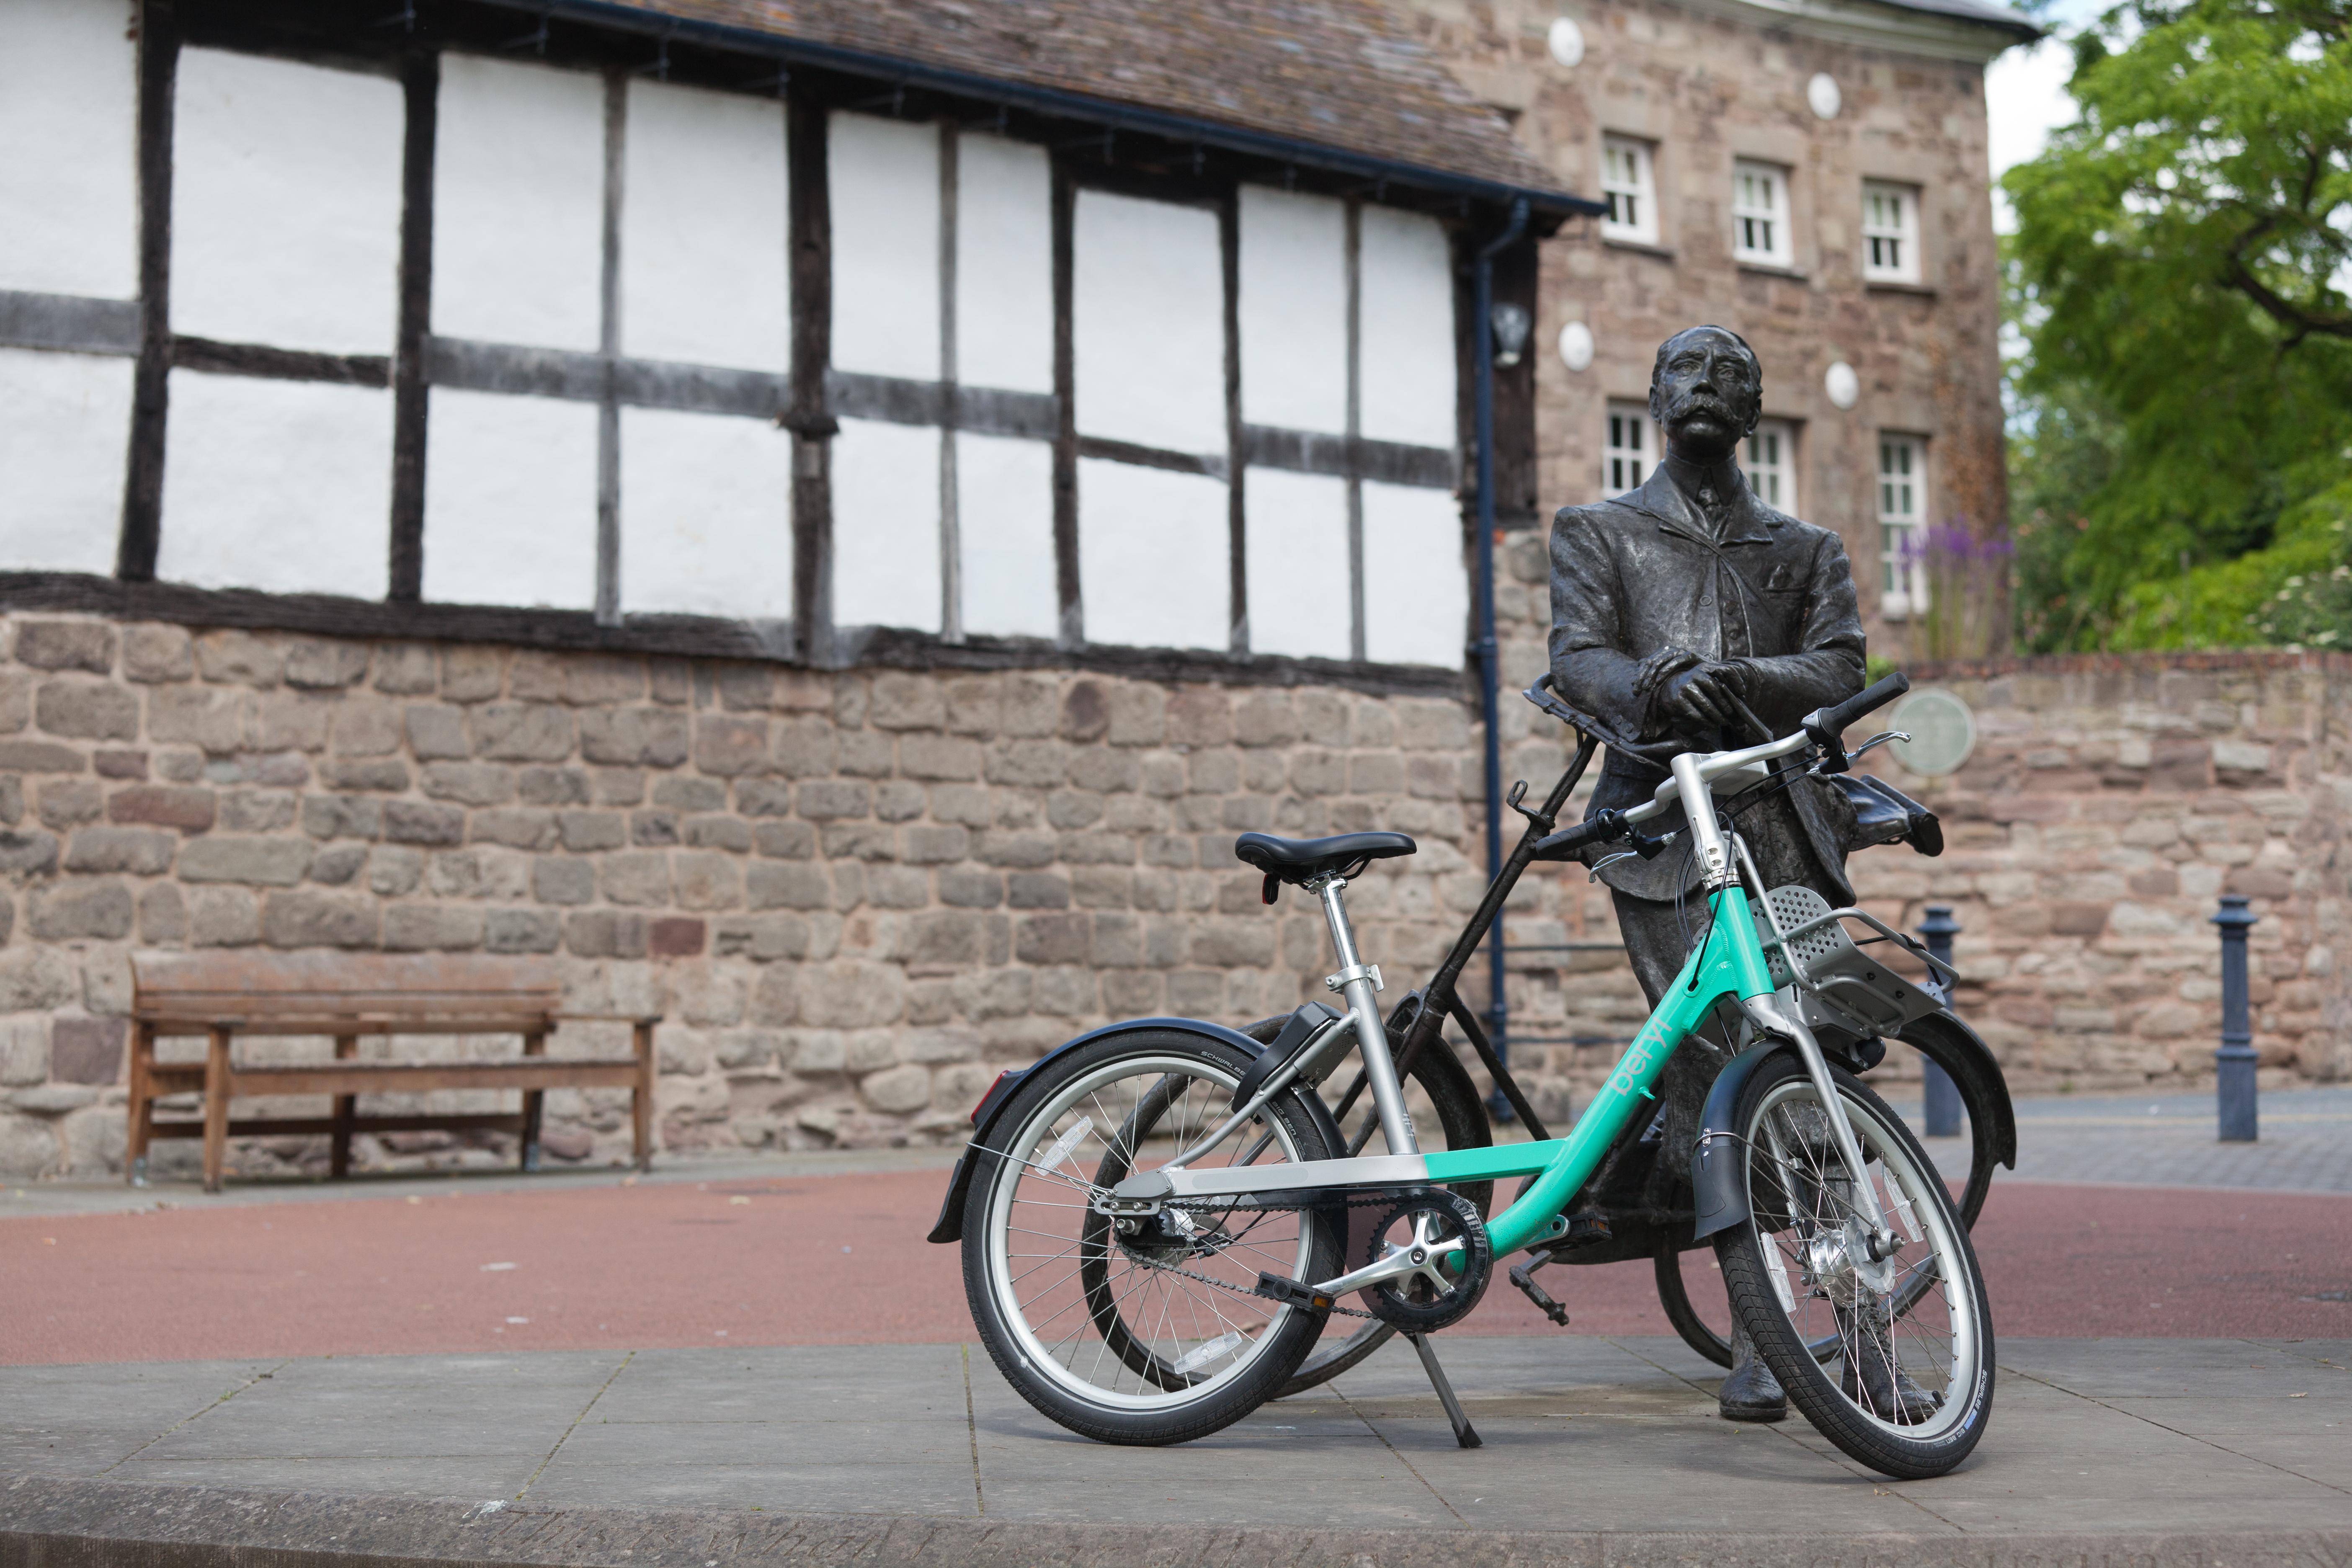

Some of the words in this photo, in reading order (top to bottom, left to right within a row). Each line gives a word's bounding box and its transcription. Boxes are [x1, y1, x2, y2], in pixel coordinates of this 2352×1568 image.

[1200, 1051, 1246, 1076] SCHWALBE
[1608, 1016, 1673, 1096] beryl
[1272, 1101, 1285, 1115] BIG
[1975, 1369, 1988, 1410] SCHWALBE
[1956, 1428, 1965, 1438] BIG
